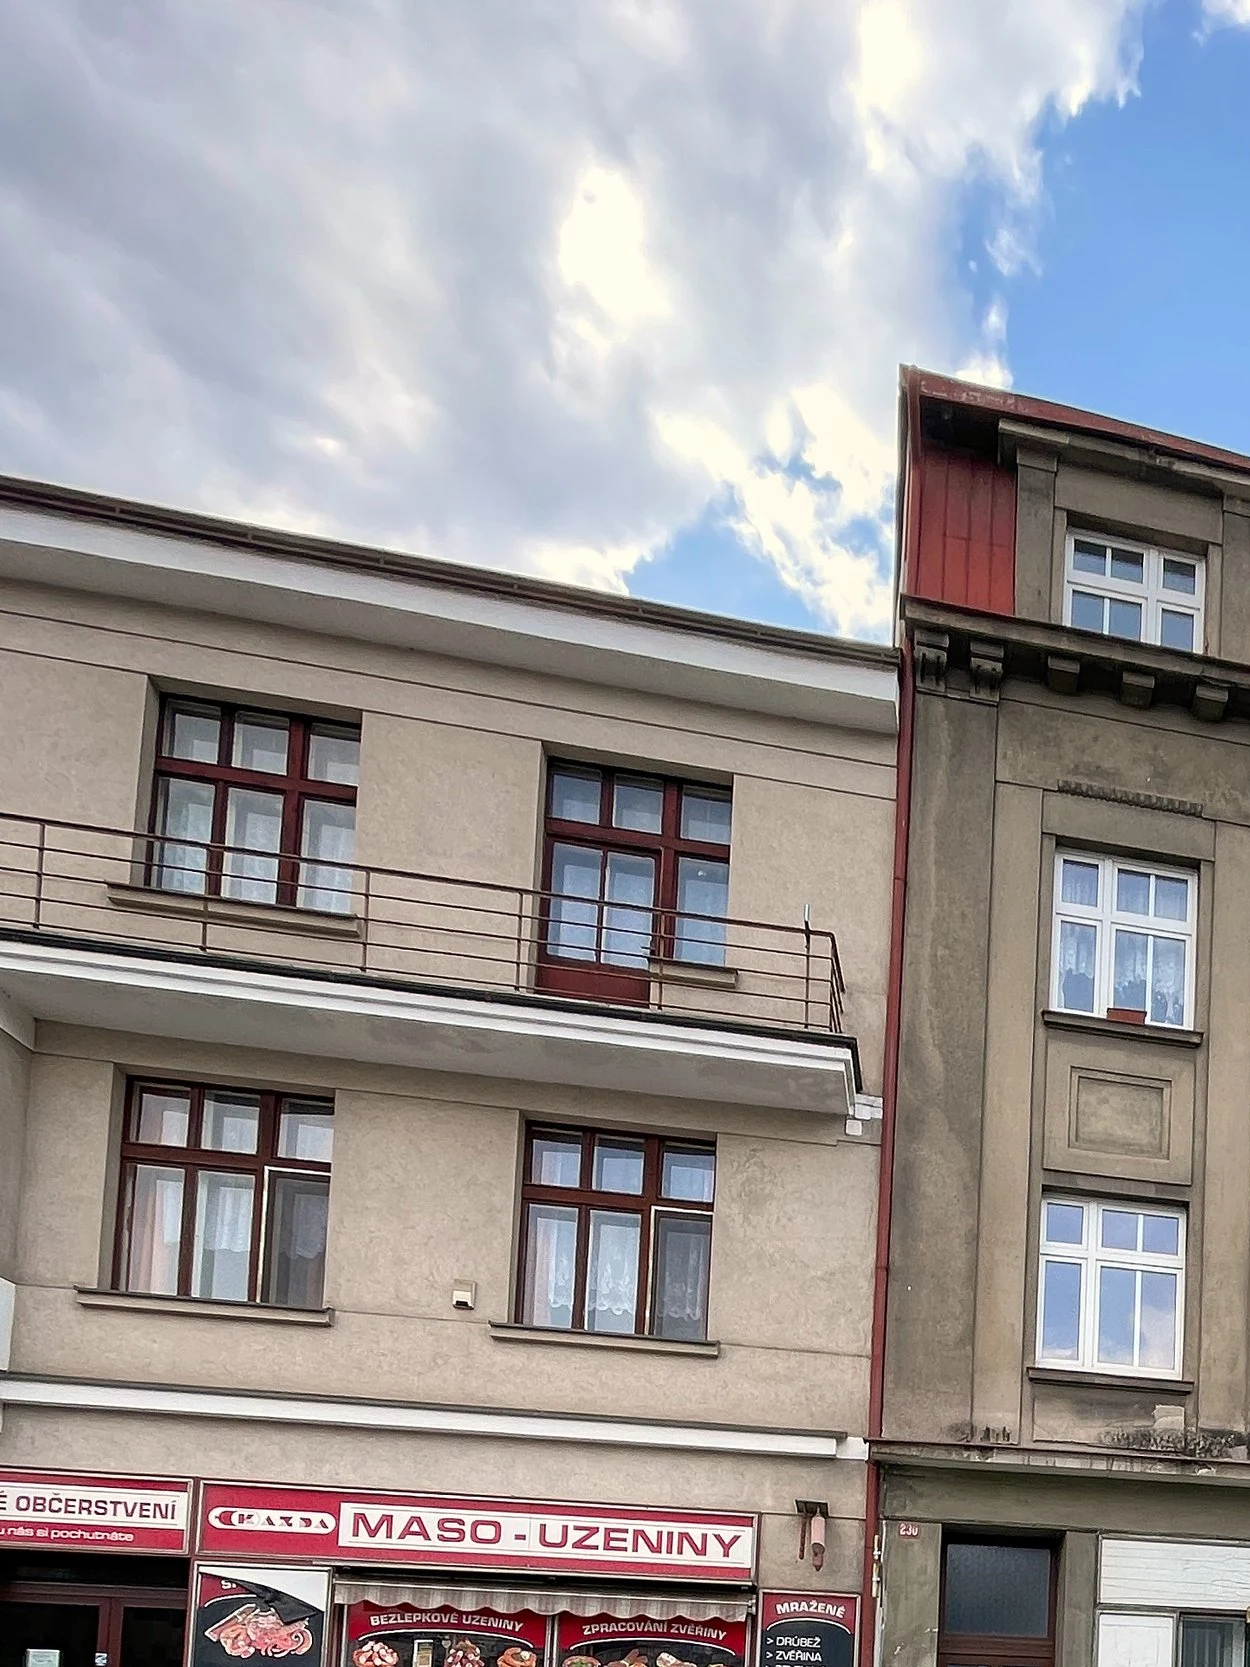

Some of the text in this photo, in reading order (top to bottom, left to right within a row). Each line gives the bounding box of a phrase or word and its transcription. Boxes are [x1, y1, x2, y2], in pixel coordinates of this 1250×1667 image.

[15, 1492, 177, 1520] OBČERSTVENÍ
[352, 1512, 502, 1545] MASO
[539, 1523, 742, 1558] UZENINY
[775, 1600, 846, 1619] MRAŽENÉ
[370, 1611, 524, 1633] BEZLEPKOVÉ UZENINY
[582, 1620, 668, 1635] ZPRACOVÁNÍ
